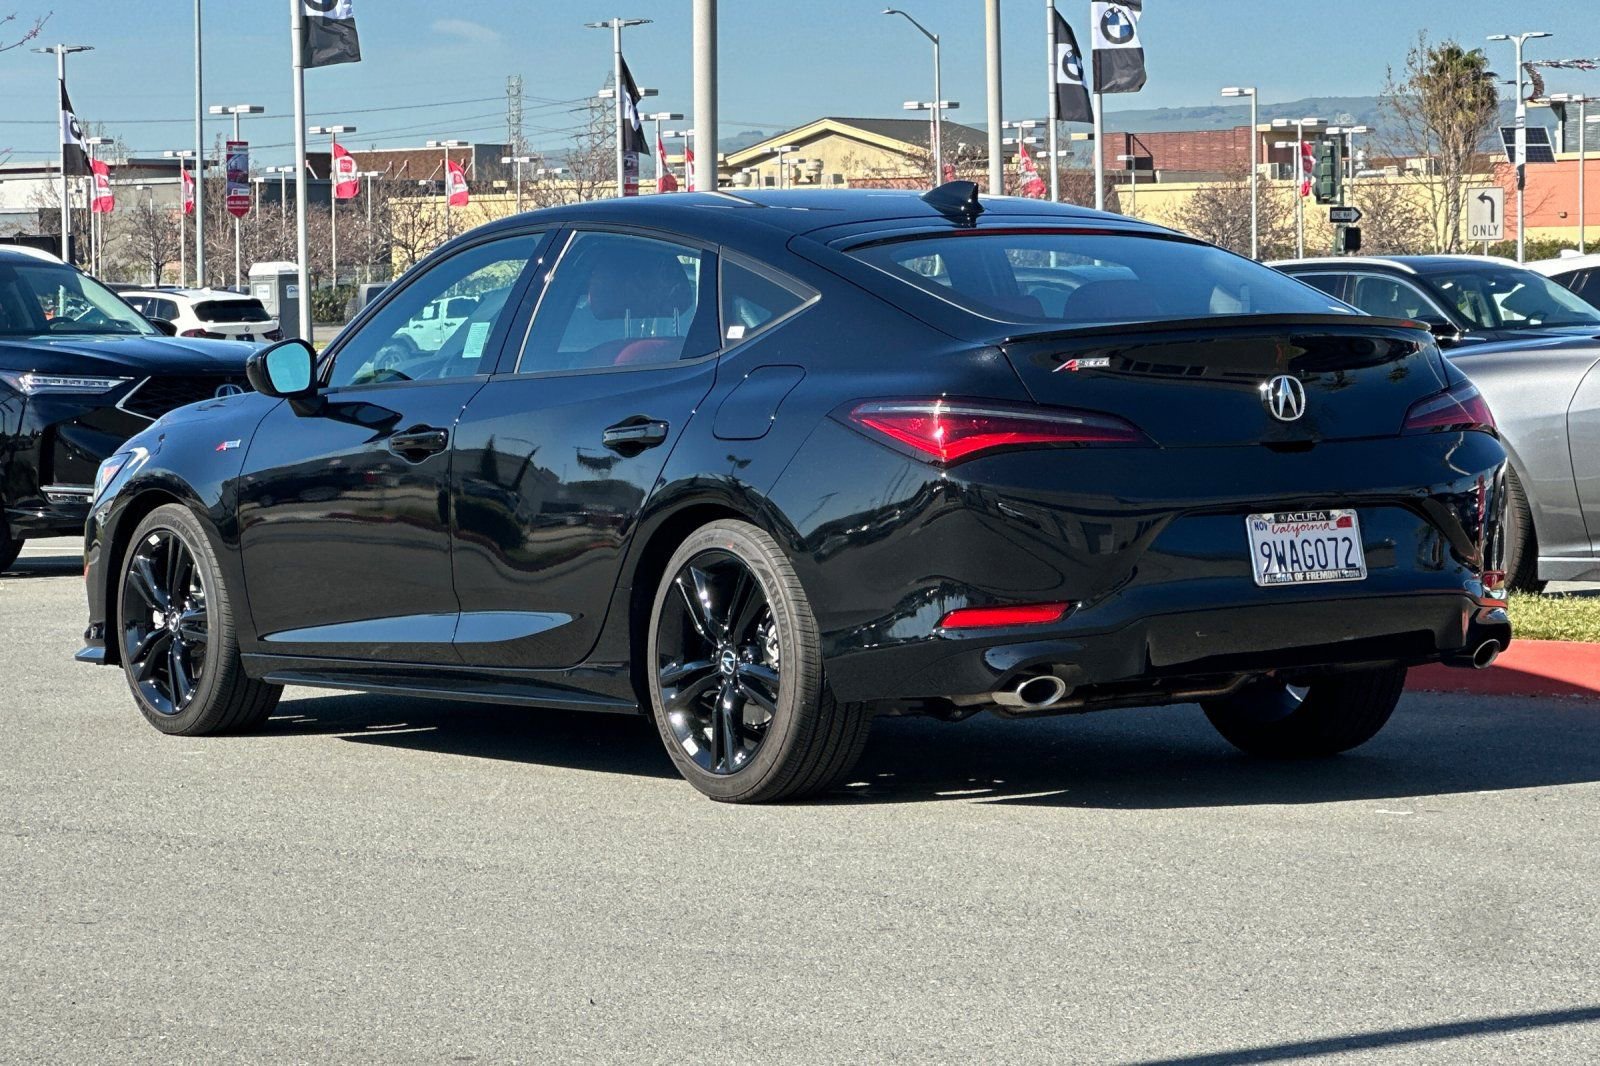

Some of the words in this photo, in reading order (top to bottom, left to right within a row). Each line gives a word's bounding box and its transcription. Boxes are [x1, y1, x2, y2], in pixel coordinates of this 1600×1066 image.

[1472, 224, 1499, 237] ONLY
[1287, 512, 1327, 522] ACURA
[1254, 521, 1268, 531] NOV
[1271, 522, 1337, 538] California
[1260, 536, 1357, 573] 9WAG072
[1295, 571, 1306, 581] OF
